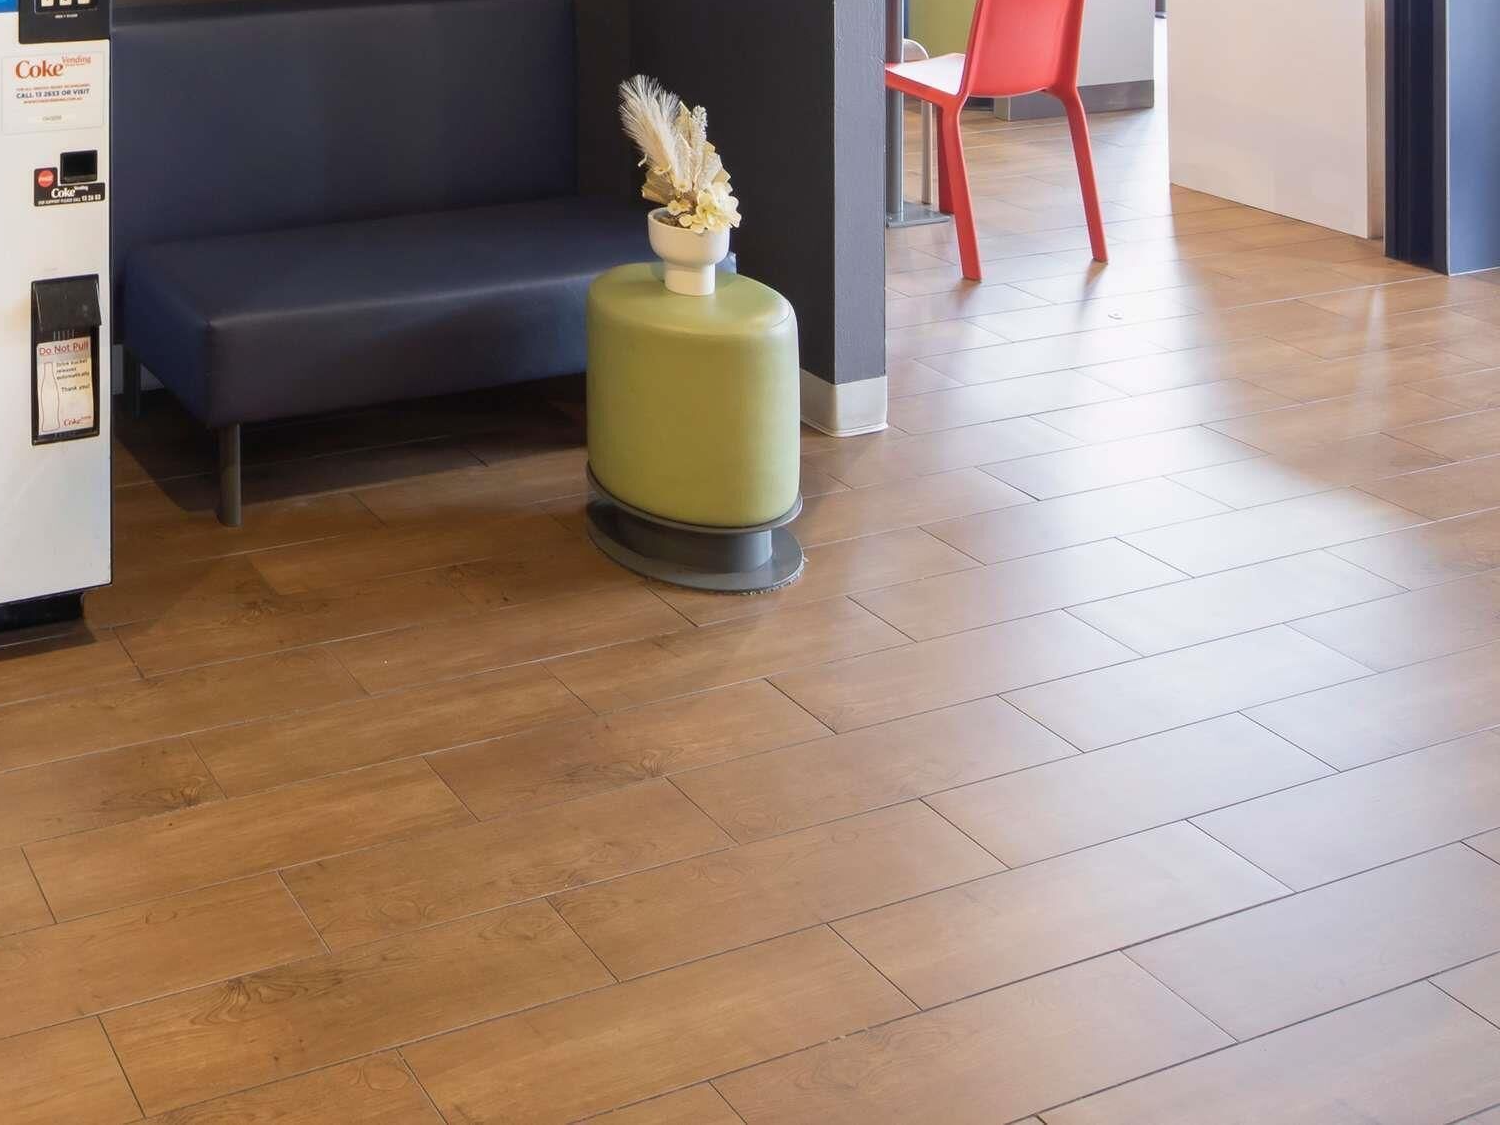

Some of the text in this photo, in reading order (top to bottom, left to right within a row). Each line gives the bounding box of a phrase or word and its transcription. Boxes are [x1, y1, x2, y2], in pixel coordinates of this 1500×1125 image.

[15, 55, 92, 80] Coke Vending
[16, 91, 34, 100] CALL
[61, 89, 72, 97] OR
[73, 87, 91, 95] VISIT
[51, 187, 76, 198] Coke
[39, 341, 89, 355] Do Not Pull
